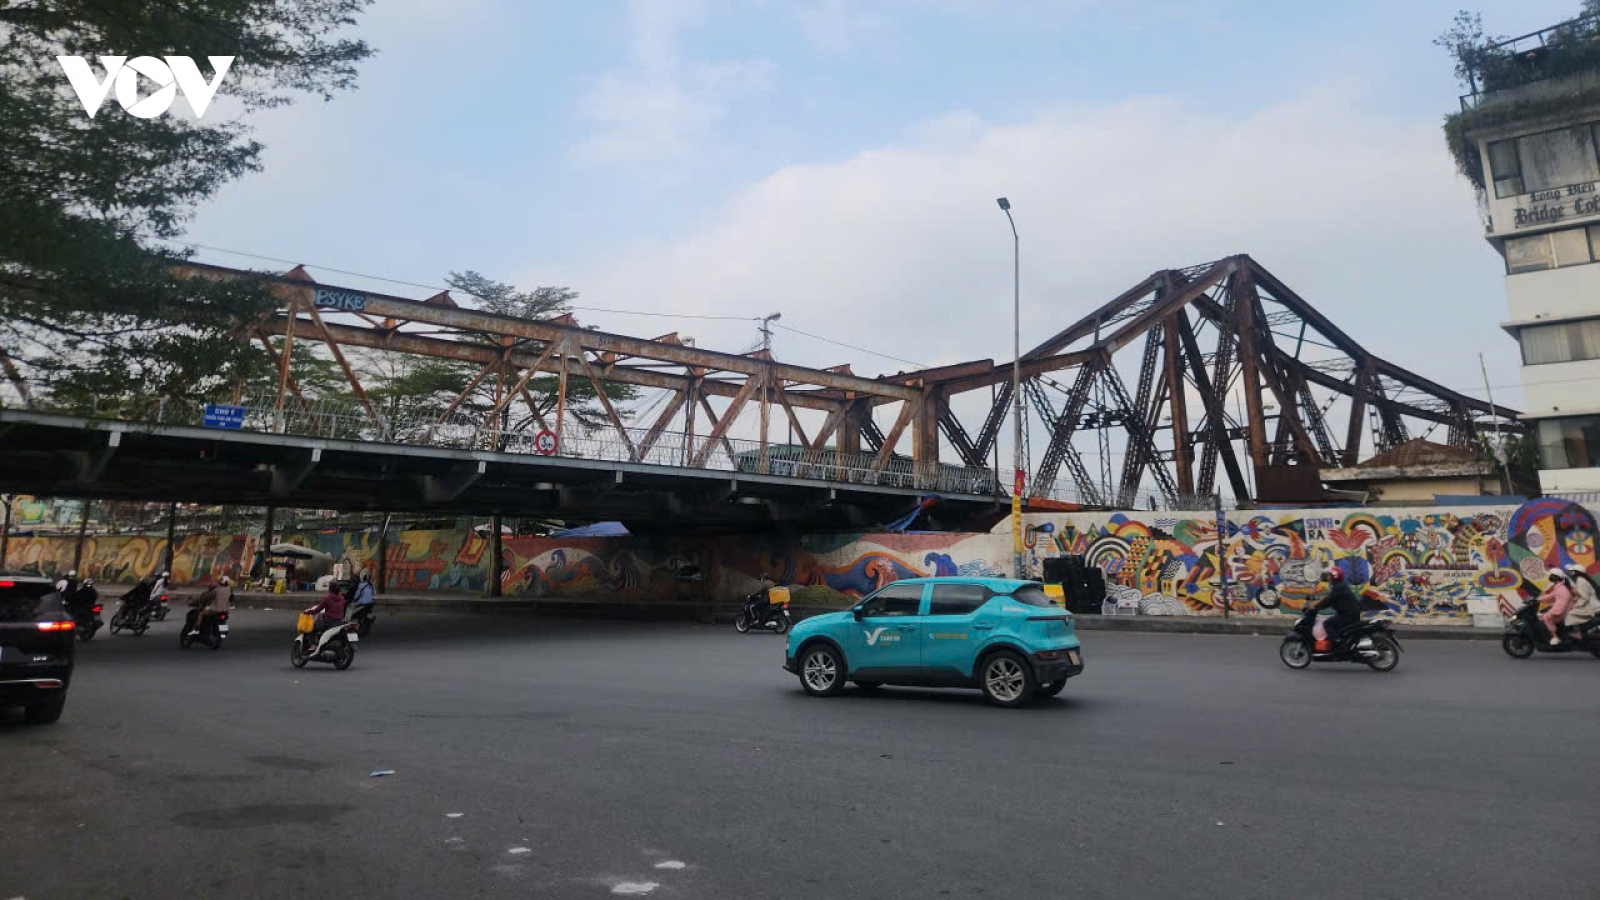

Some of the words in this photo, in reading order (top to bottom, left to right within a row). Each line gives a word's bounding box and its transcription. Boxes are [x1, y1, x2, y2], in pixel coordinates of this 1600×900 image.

[1514, 204, 1565, 223] Bridge
[315, 289, 365, 310] PSYKE
[1308, 529, 1325, 540] RA
